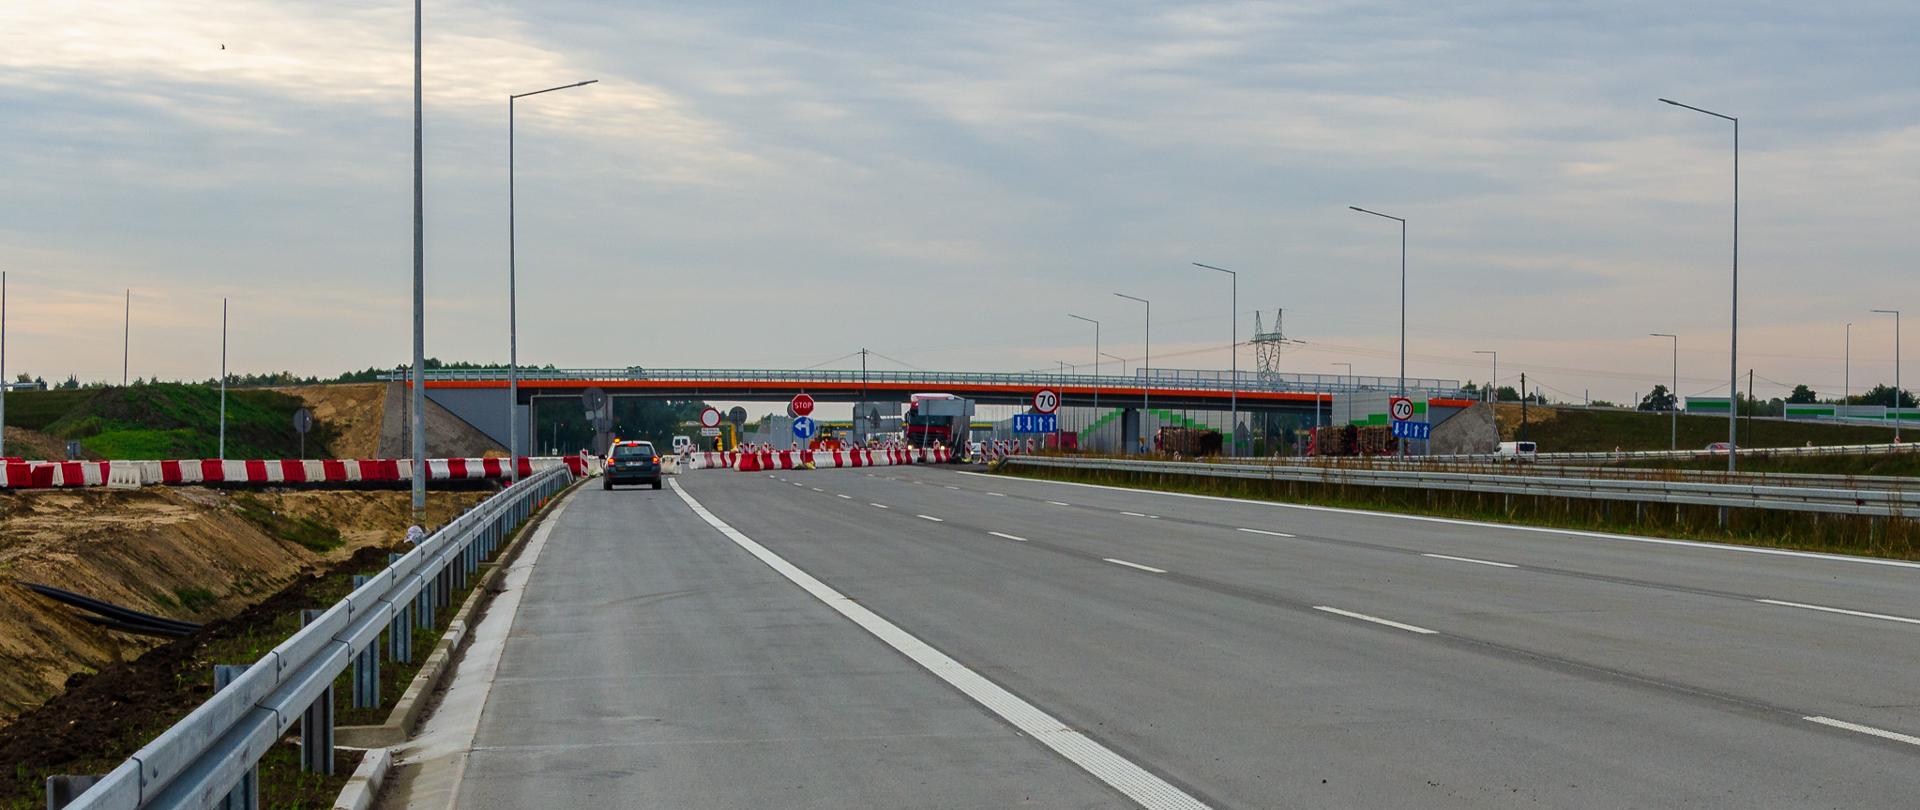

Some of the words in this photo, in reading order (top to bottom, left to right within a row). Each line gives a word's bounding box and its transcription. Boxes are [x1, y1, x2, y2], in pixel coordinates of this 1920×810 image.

[794, 401, 812, 409] STOP
[1039, 395, 1055, 408] 70
[1397, 404, 1410, 415] 70
